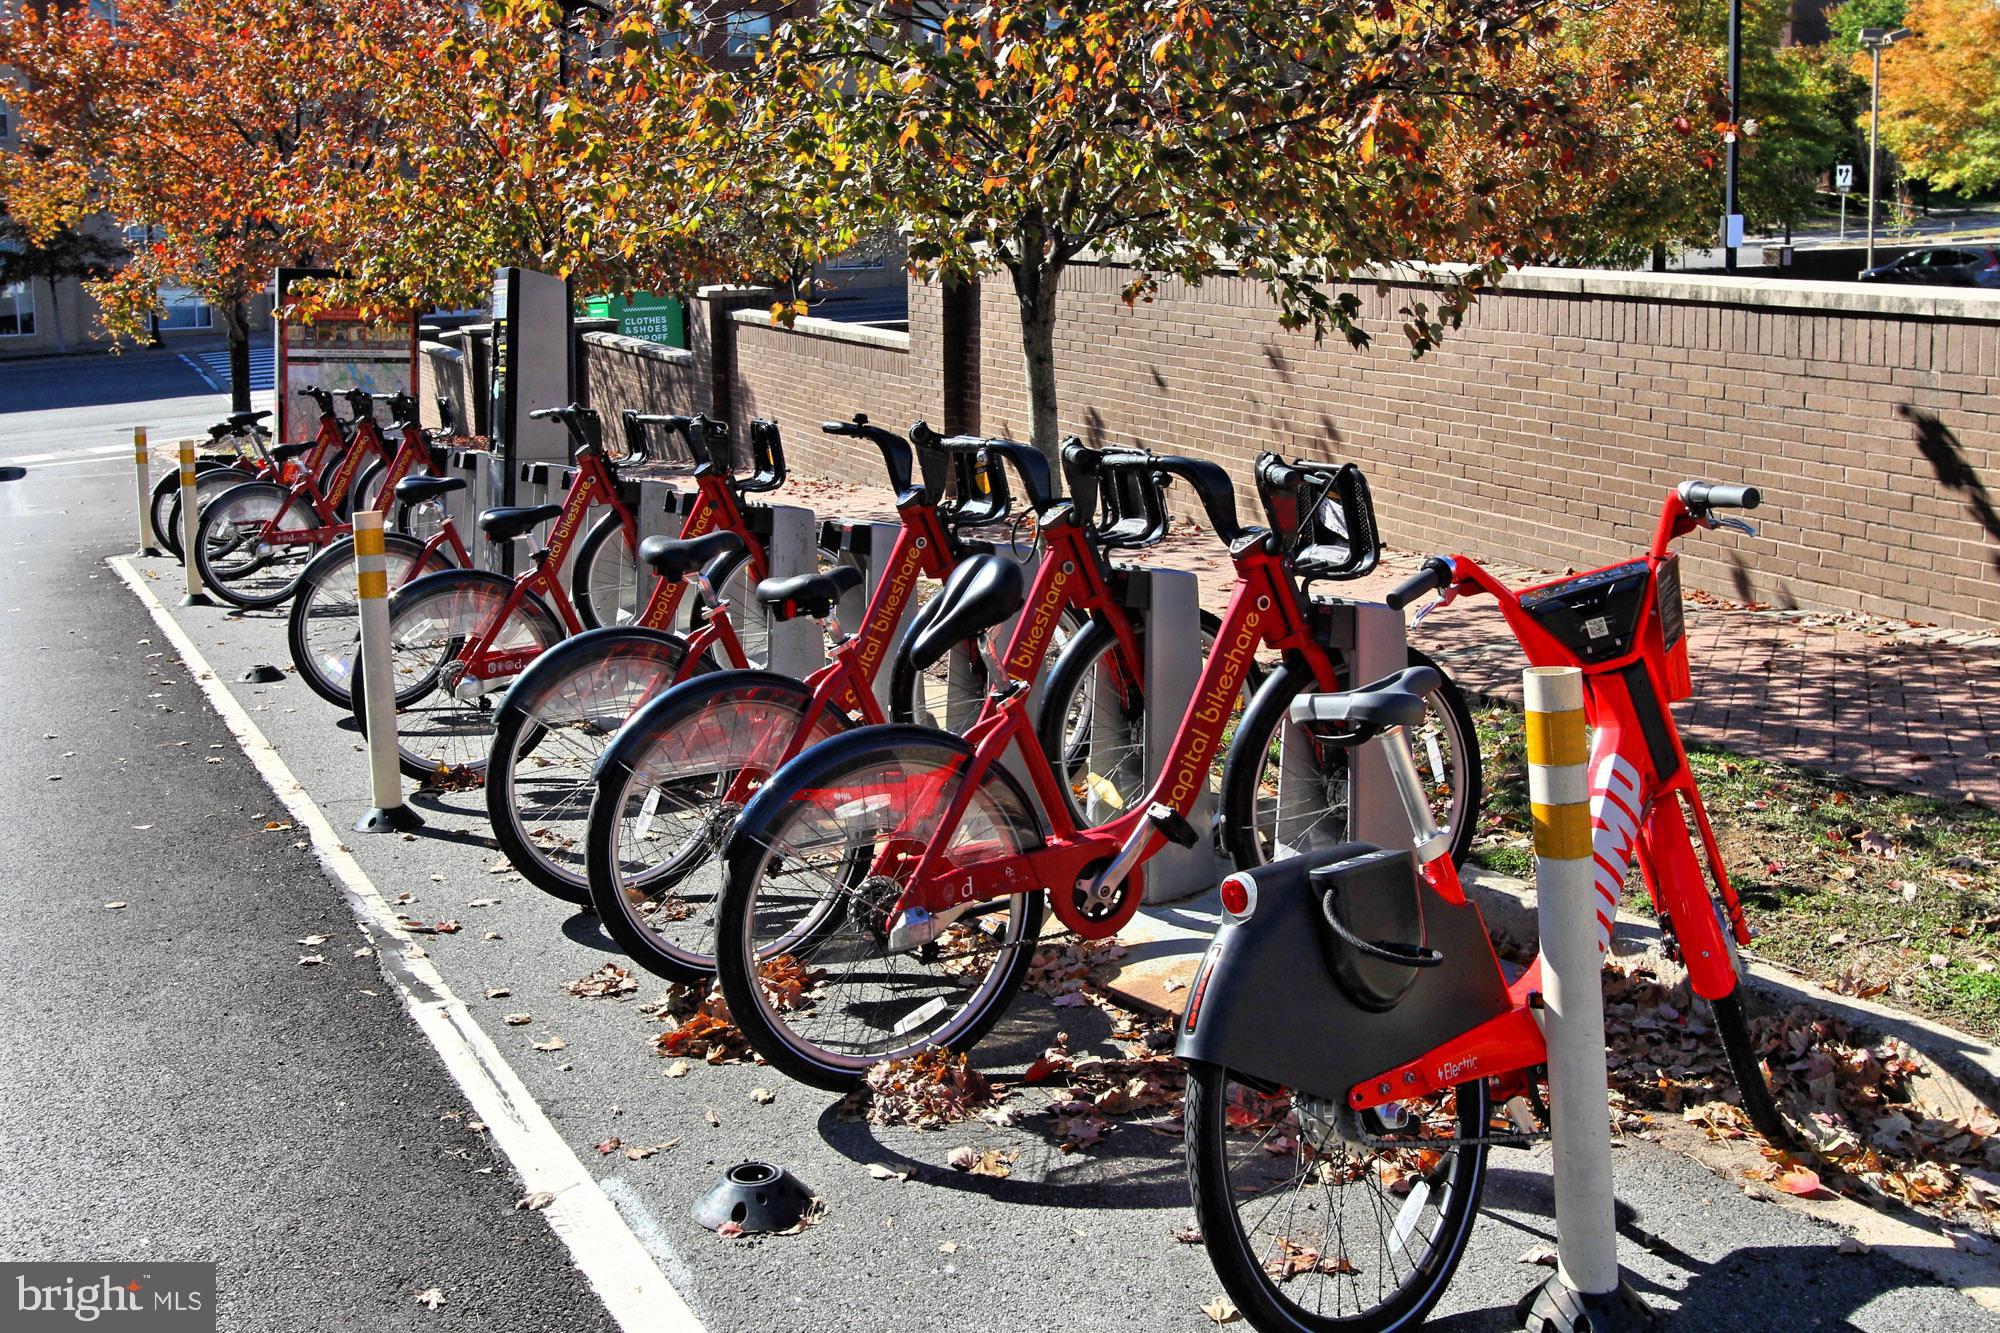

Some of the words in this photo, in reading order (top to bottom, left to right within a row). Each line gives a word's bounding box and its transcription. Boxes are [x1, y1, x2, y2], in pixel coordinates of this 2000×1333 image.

[625, 316, 667, 325] CLOTHES
[652, 333, 668, 341] OFF
[555, 481, 591, 538] bikeshare
[648, 582, 678, 629] capita
[870, 547, 921, 632] bikeshare
[1010, 571, 1067, 669] bikeshare
[1195, 611, 1260, 724] bikeshare
